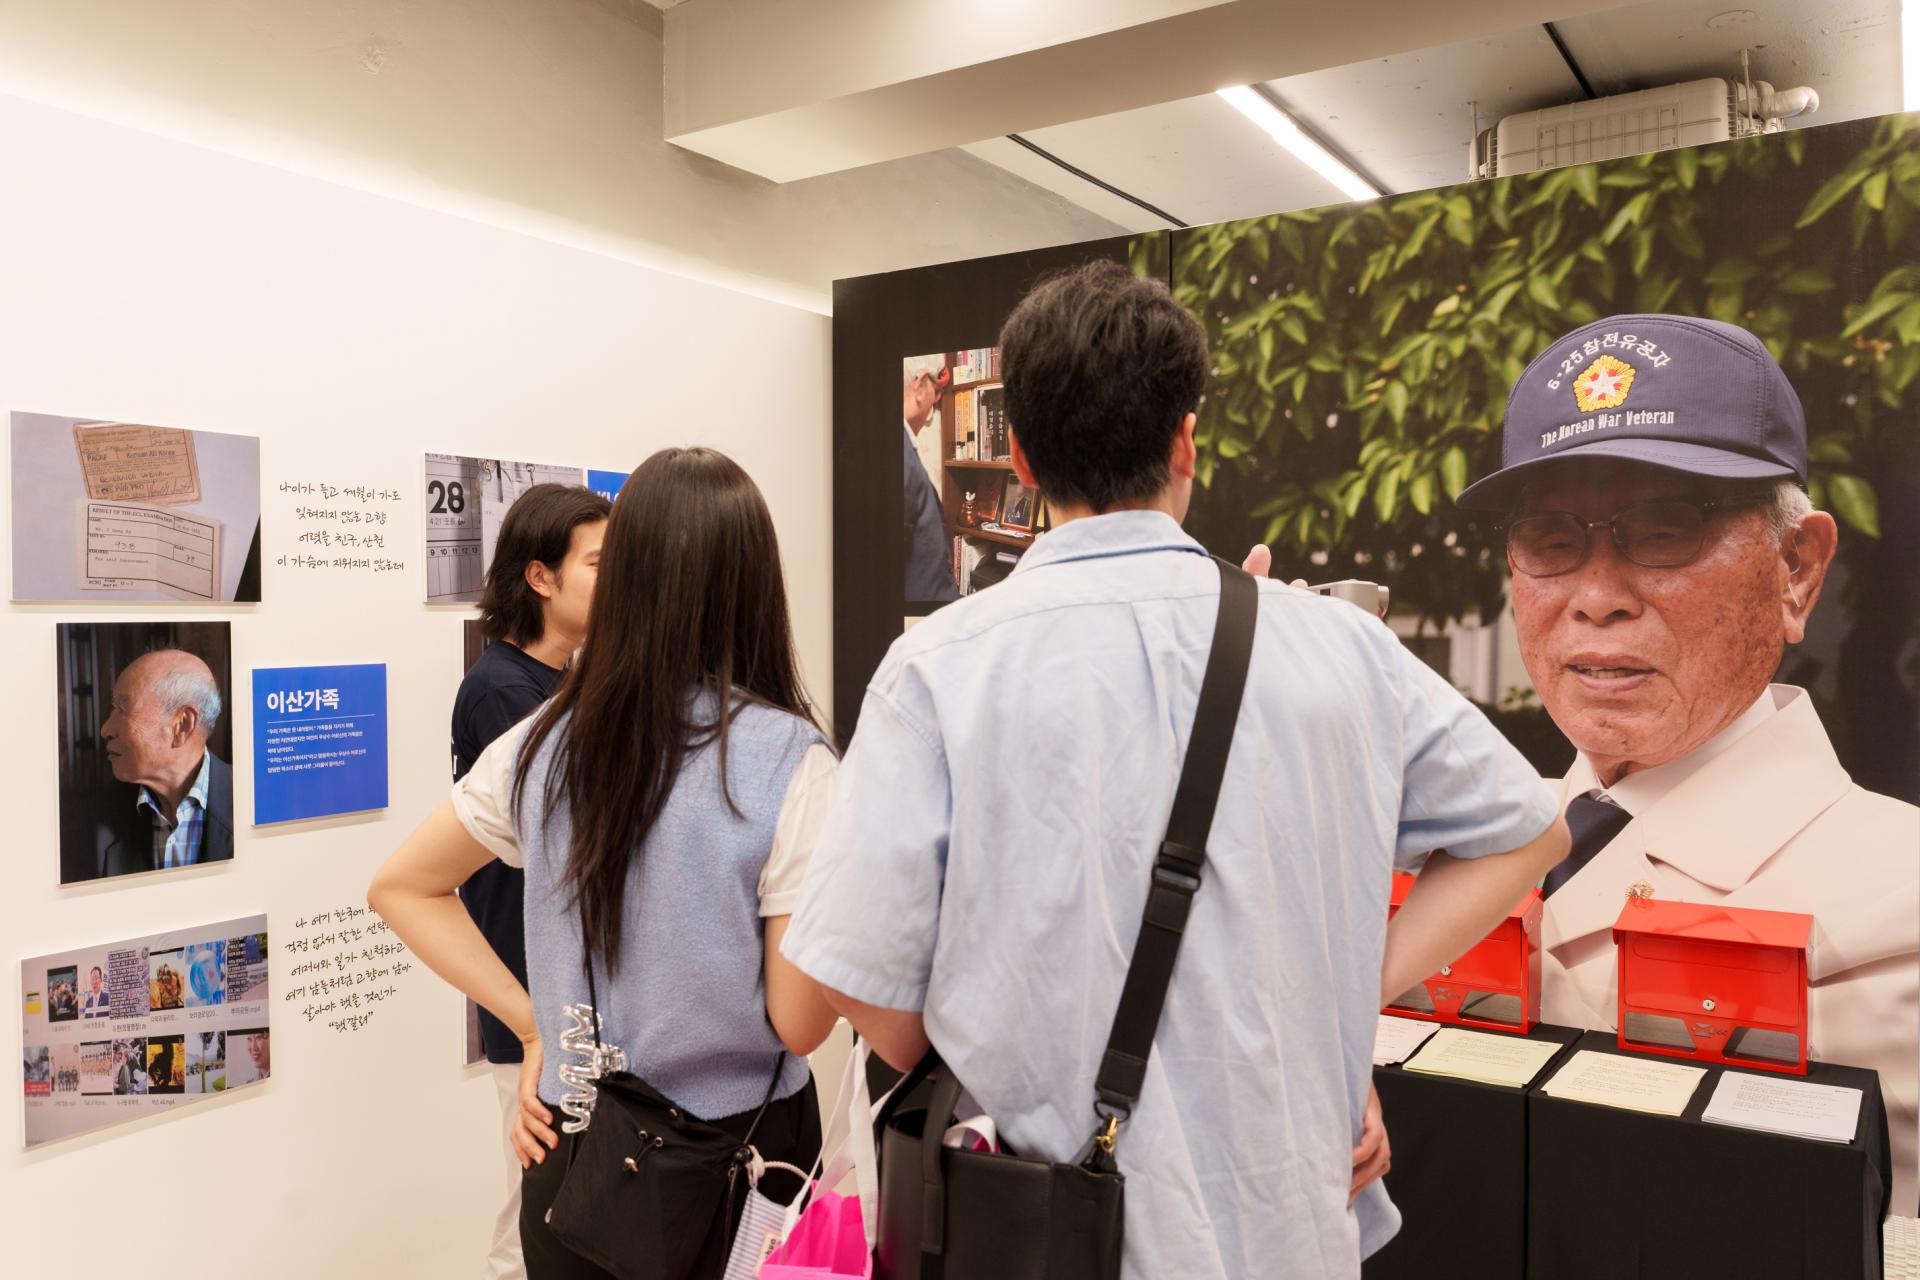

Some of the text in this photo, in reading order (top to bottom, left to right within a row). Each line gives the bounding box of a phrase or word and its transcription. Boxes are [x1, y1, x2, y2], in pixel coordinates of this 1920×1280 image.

[1541, 409, 1675, 448] The Korean War Veteran
[279, 482, 402, 503] 나이가 들고 세월이 가도
[427, 480, 465, 513] 28
[296, 507, 387, 525] 잊혀지지 않는 고향
[334, 533, 361, 547] 친구,
[430, 548, 436, 557] 9
[440, 548, 448, 556] 10
[277, 555, 287, 566] 이
[291, 555, 329, 569] 가슴에
[333, 557, 370, 569] 지워지지
[266, 688, 340, 714] 이산가족
[295, 918, 307, 928] 나
[311, 912, 330, 926] 여기
[334, 906, 364, 922] 한국에
[285, 938, 308, 954] 걱정
[338, 928, 362, 944] 잘한
[291, 959, 331, 976] 어머니와
[361, 942, 406, 960] 친척하고
[285, 961, 412, 1001] 여기 남들처럼 고향에 남아
[302, 1001, 337, 1021] 살아야
[364, 985, 397, 1003] 것인가
